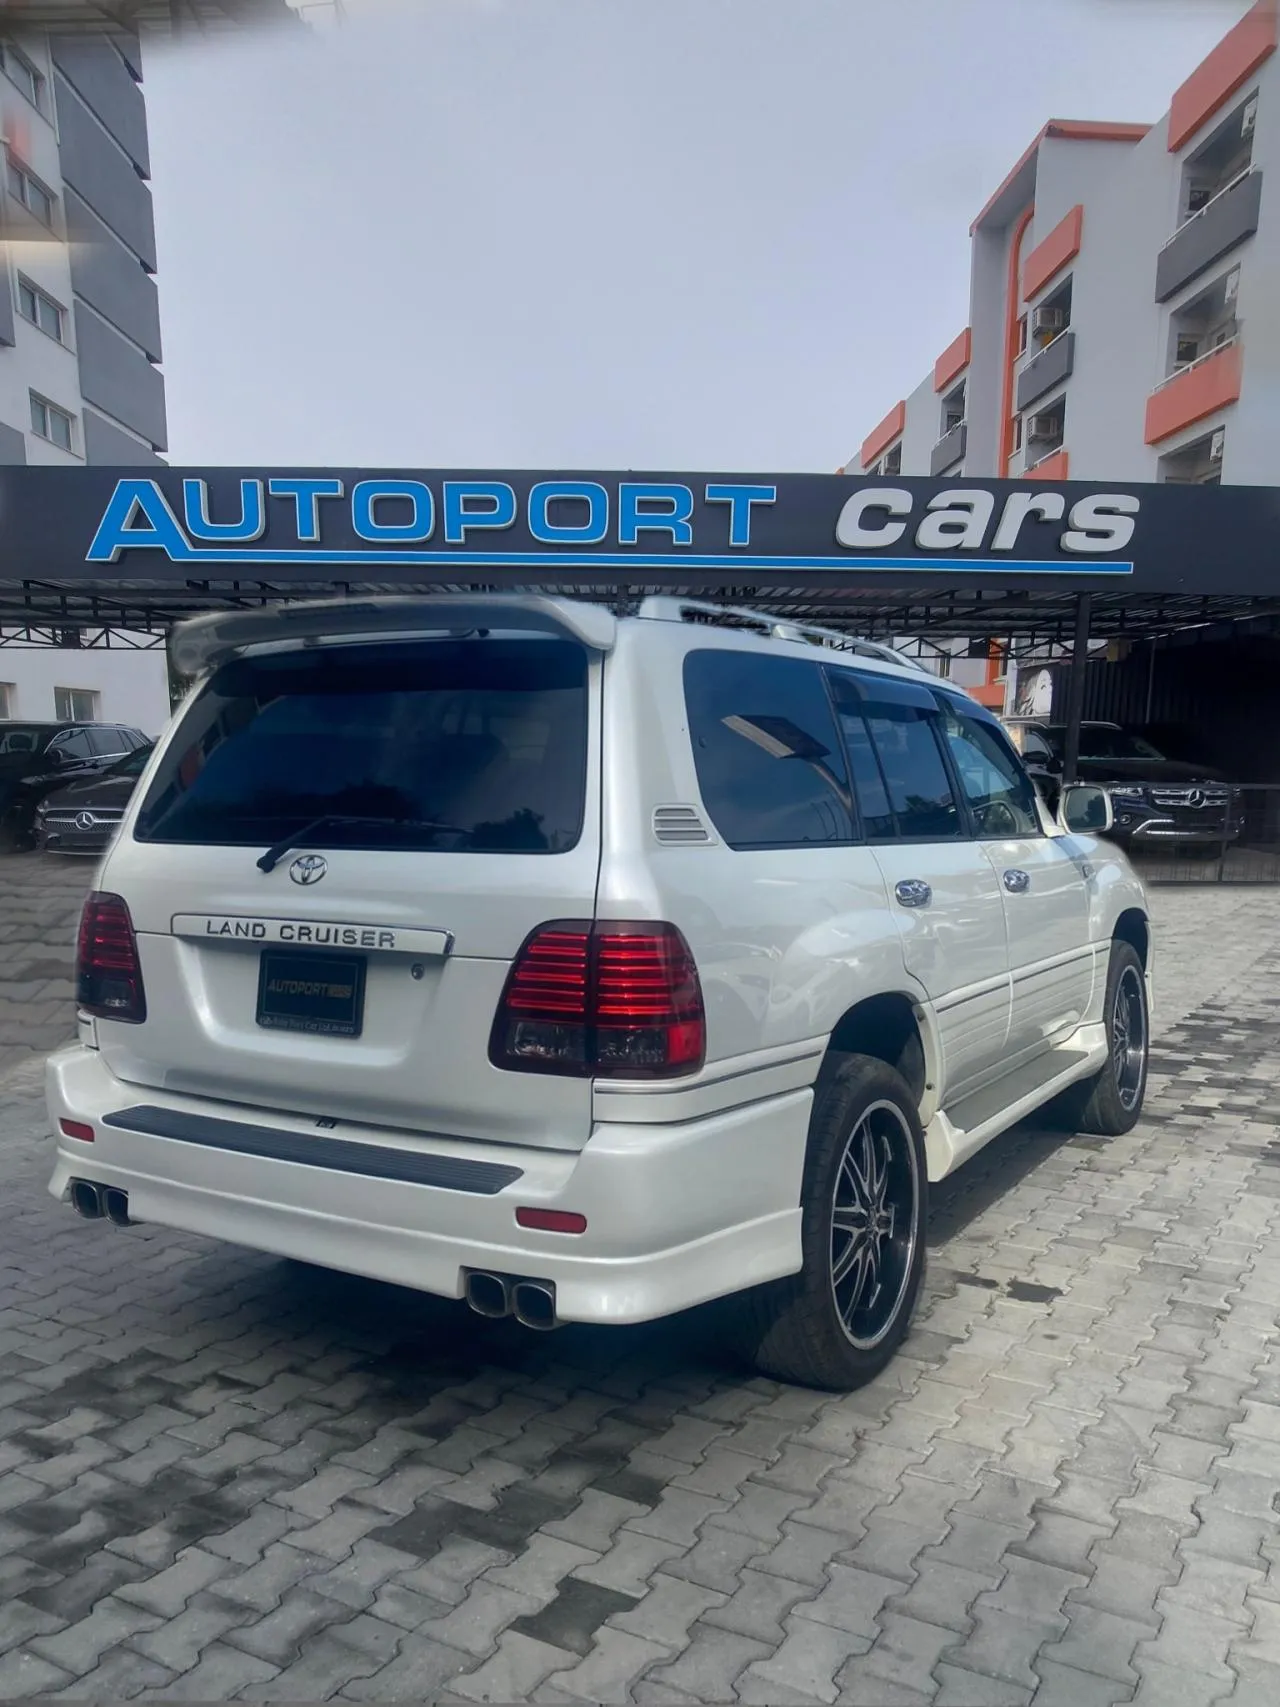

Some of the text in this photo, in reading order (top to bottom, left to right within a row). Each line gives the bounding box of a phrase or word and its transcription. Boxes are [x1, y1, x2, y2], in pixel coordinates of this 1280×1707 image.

[85, 477, 1141, 562] AUTOPORT cars
[206, 919, 396, 949] LAND CRUISER
[267, 978, 328, 997] AUTOPORT
